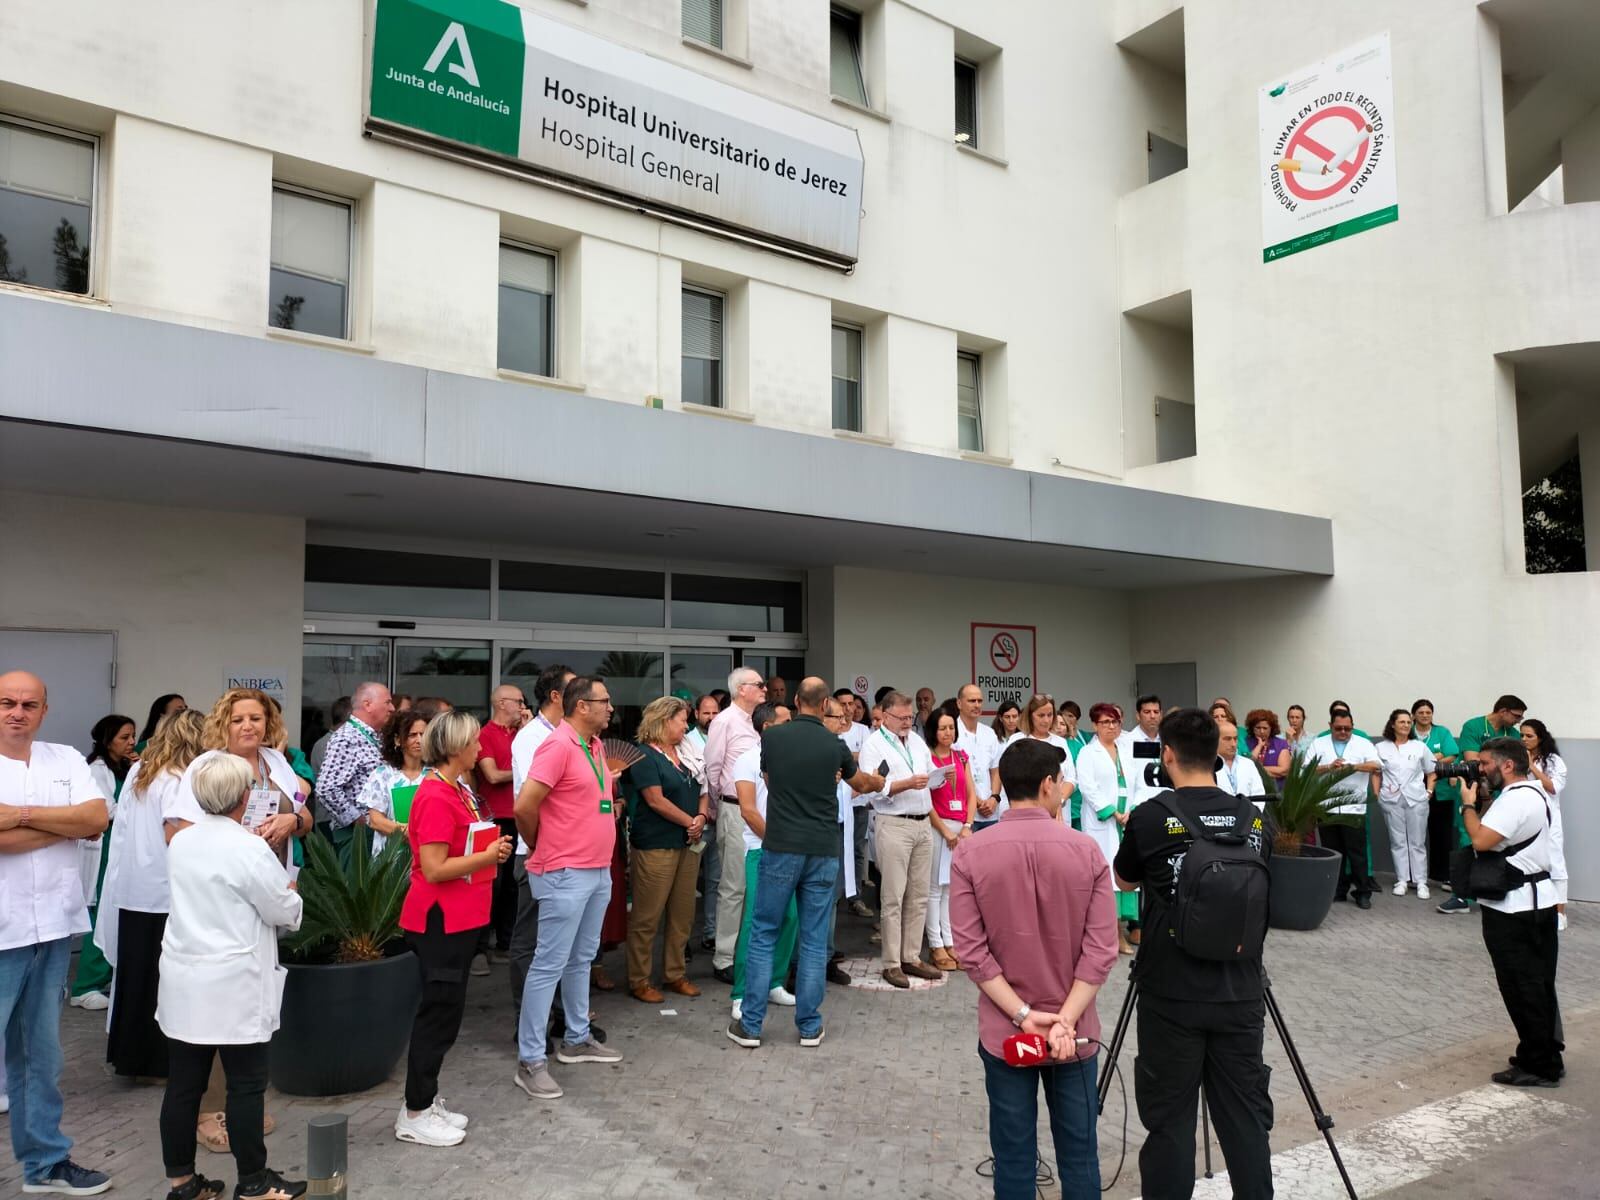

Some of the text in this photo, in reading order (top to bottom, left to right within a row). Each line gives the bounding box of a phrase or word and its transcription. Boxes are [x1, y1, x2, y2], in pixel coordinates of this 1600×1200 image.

[385, 67, 510, 116] Junta de Andalucía
[1313, 91, 1342, 109] TODO
[1344, 91, 1355, 102] EL
[1298, 104, 1312, 119] EN
[1355, 94, 1384, 132] RECINTO
[543, 76, 848, 198] Hospital Universitario de Jerez
[1273, 117, 1299, 156] FUMAR
[540, 117, 720, 195] Hospital General
[1350, 133, 1384, 195] SANITARIO
[1270, 163, 1298, 213] PROHIBIDO
[978, 675, 1031, 689] PROHIBIDO
[988, 690, 1022, 703] FUMAR
